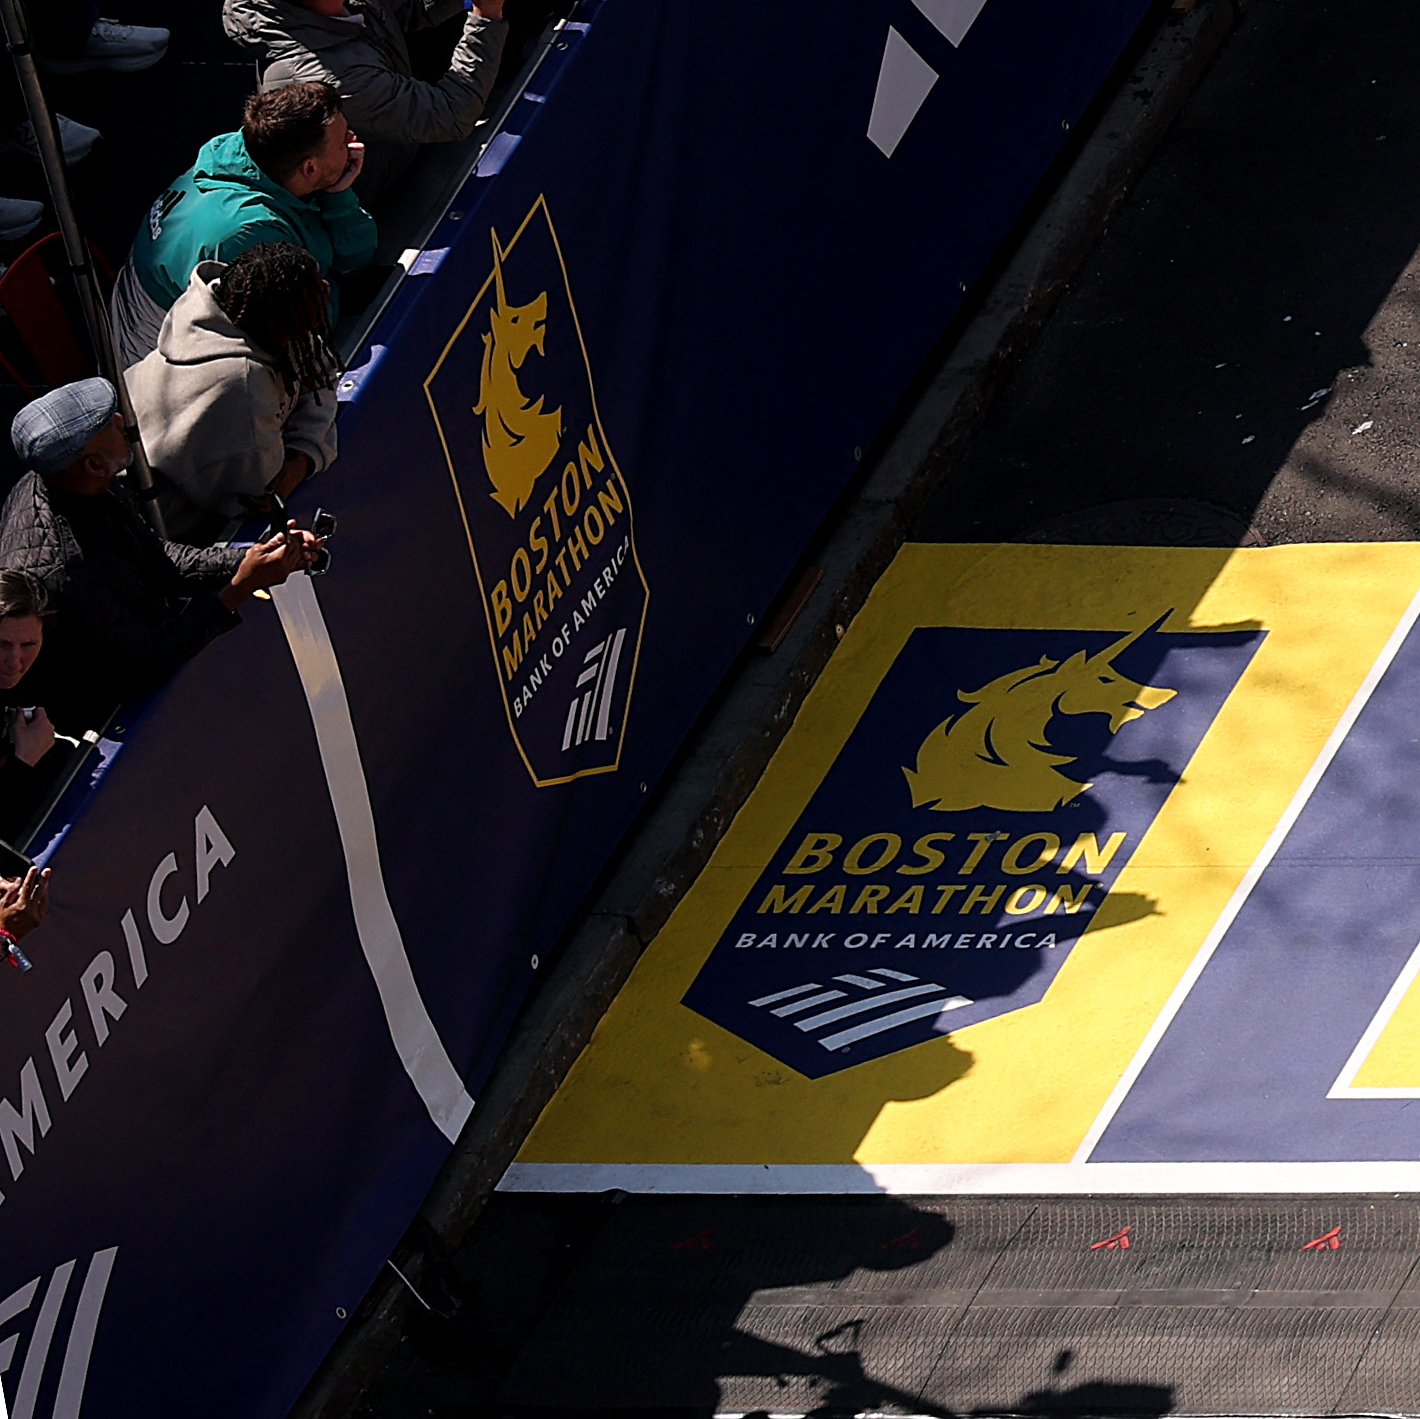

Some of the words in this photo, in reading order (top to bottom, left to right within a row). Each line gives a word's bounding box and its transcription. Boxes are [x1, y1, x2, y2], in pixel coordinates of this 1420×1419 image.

[490, 423, 606, 638] BOSTON
[502, 477, 624, 681] MARATHON
[513, 653, 553, 719] BANK
[551, 625, 572, 659] OF
[572, 535, 631, 632] AMERICA
[735, 931, 834, 951] BANK
[842, 931, 892, 951] OF
[894, 931, 1058, 951] AMERICA
[757, 882, 1092, 916] MARATHON
[781, 830, 1127, 876] BOSTON
[0, 804, 237, 1208] MERICA
